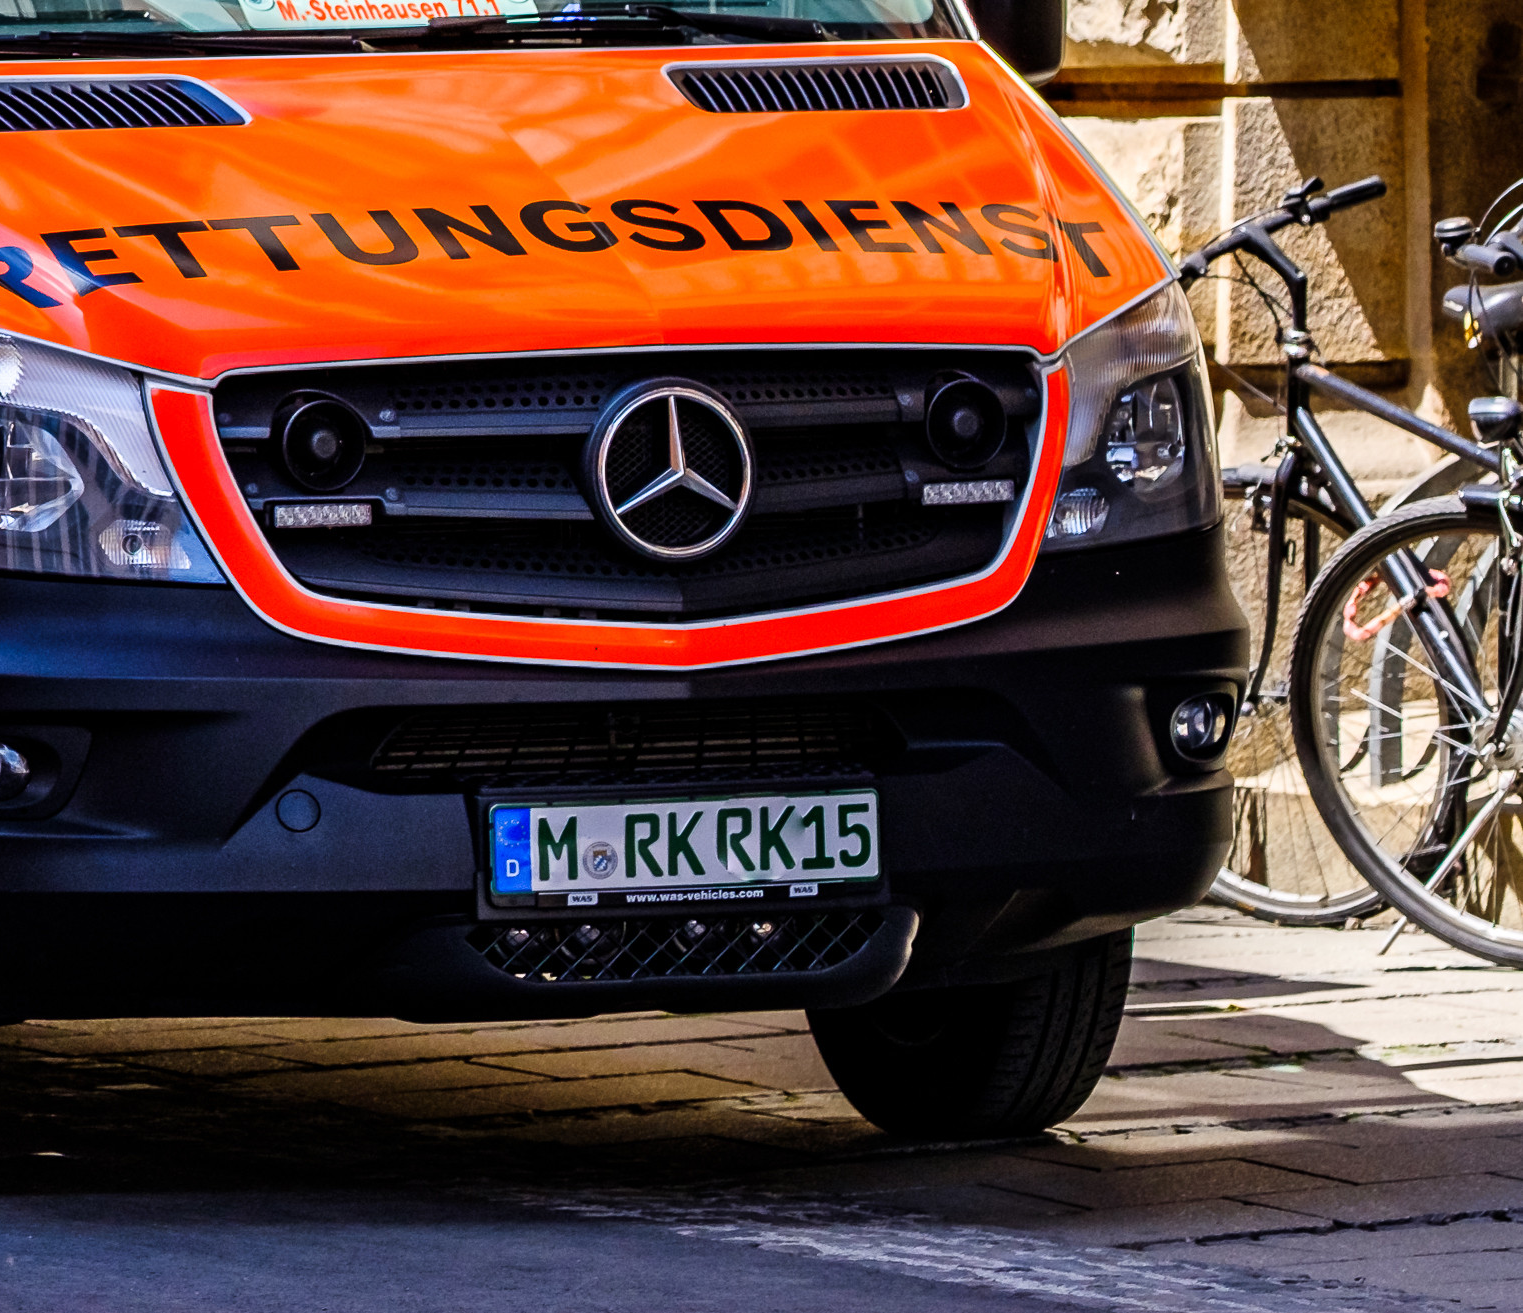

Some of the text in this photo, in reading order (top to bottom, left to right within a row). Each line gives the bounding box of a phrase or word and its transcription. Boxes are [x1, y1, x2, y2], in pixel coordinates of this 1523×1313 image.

[538, 816, 579, 881] M
[506, 859, 520, 878] D
[571, 885, 815, 904] WAS www.was-vehicles.com WAS
